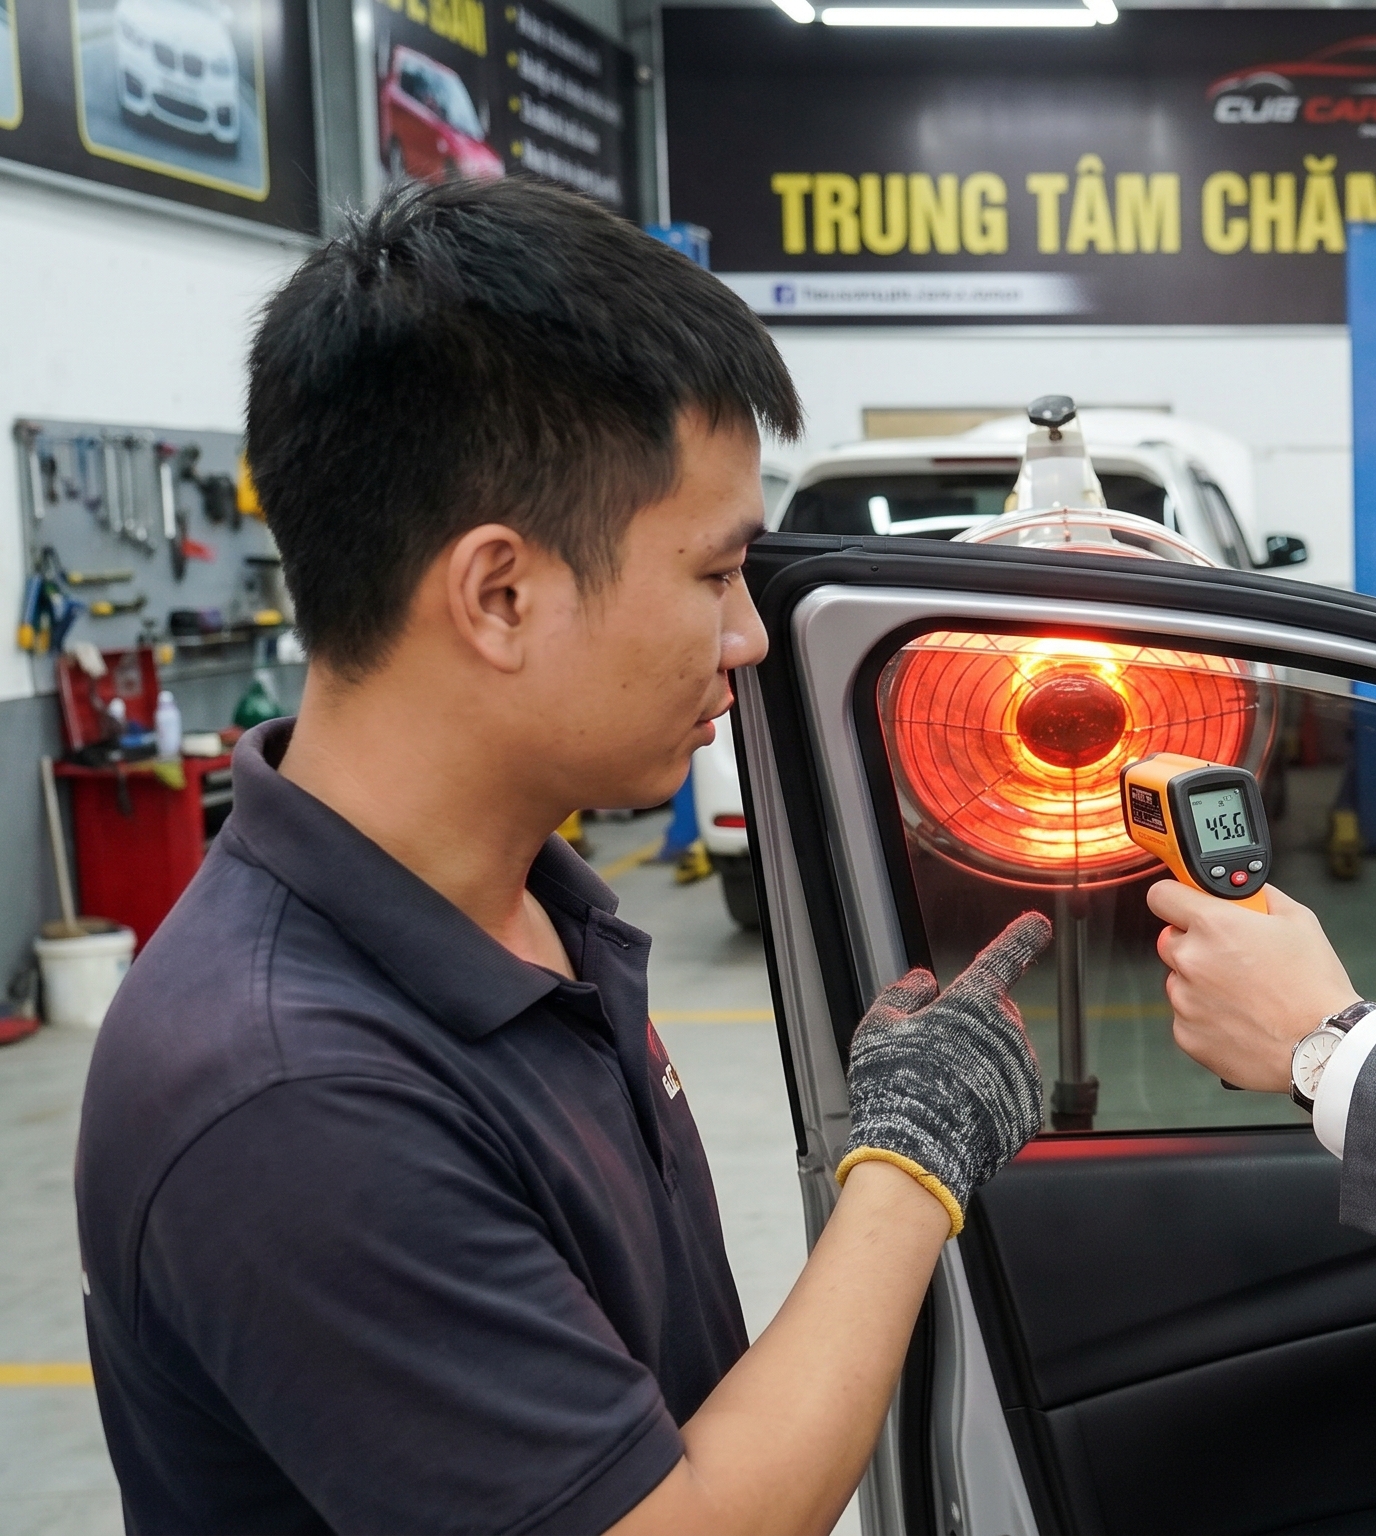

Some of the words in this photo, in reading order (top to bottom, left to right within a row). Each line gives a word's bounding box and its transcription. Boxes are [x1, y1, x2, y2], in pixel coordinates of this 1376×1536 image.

[771, 171, 1008, 255] TRUNG
[1026, 153, 1181, 255] TÂM
[1205, 812, 1246, 841] 45.6
